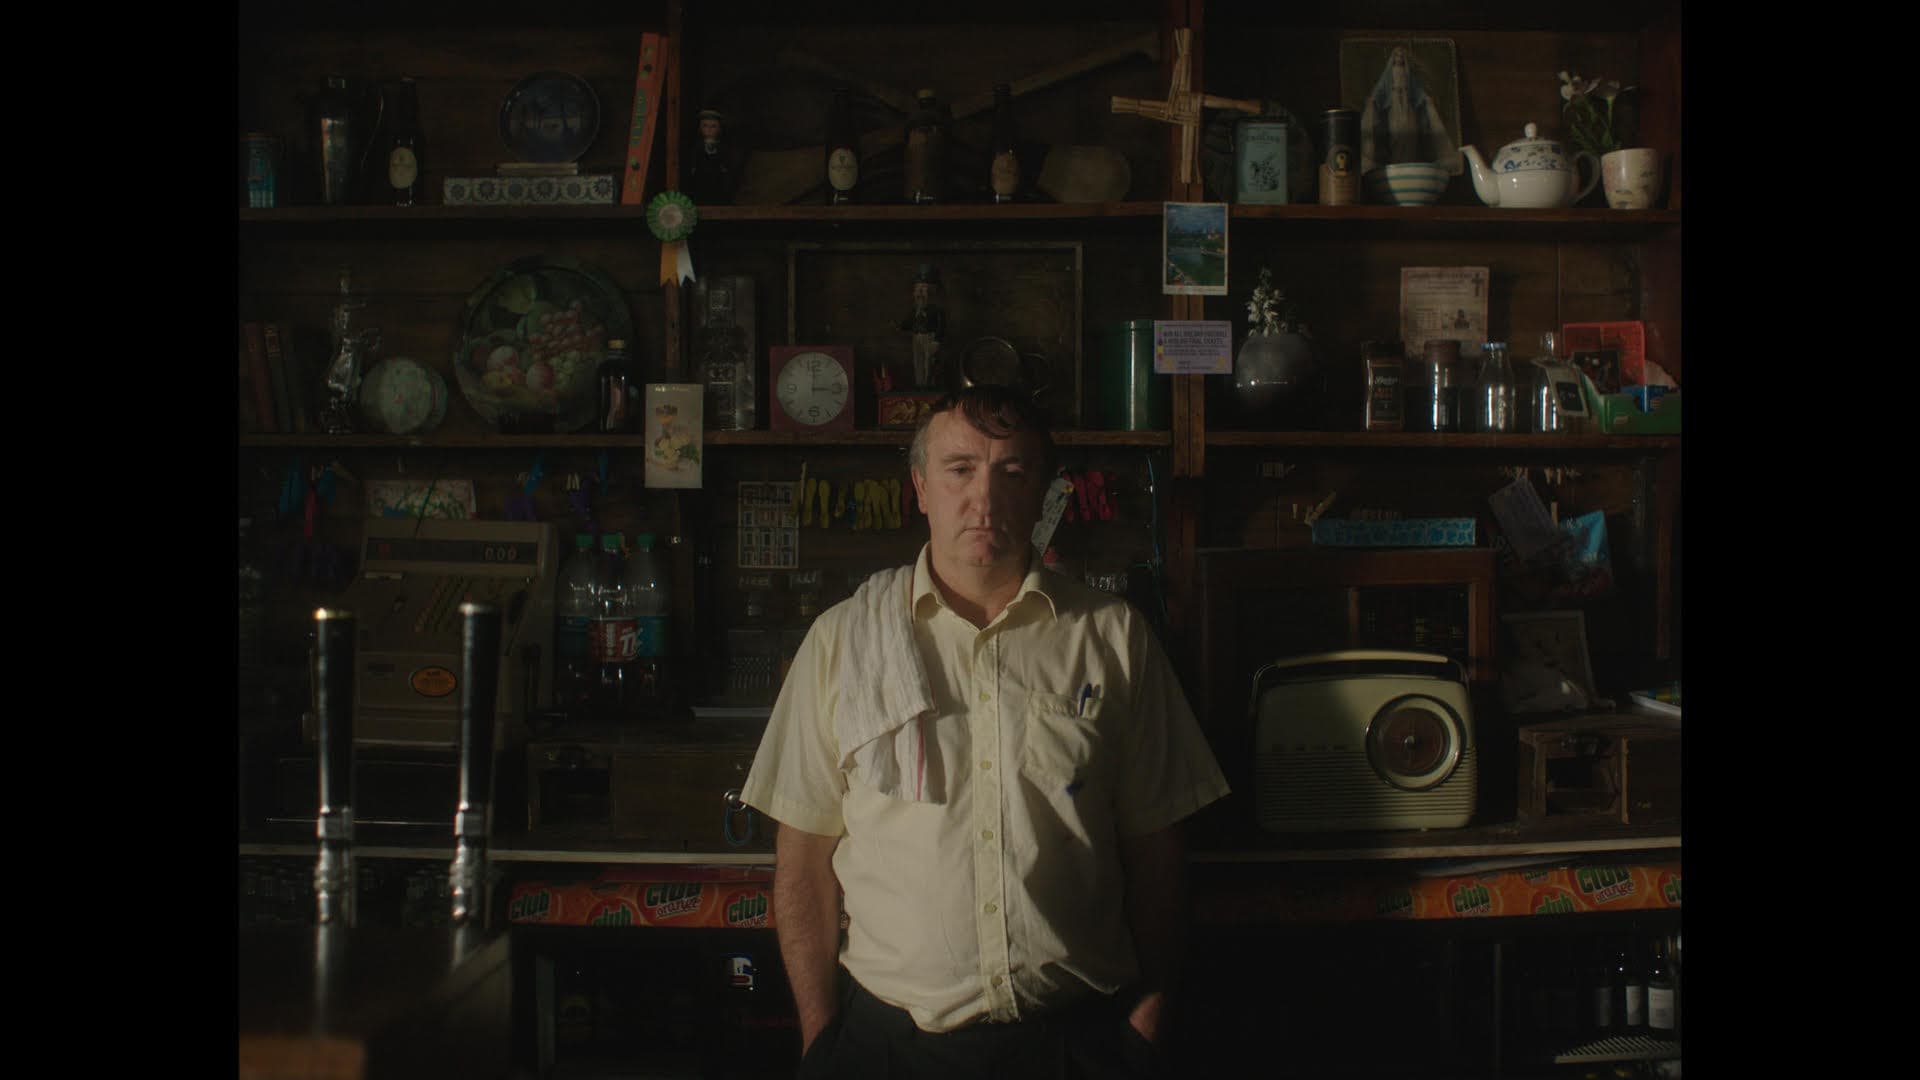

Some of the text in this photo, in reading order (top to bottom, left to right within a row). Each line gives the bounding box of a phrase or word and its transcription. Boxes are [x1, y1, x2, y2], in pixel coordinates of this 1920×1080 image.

[1575, 866, 1632, 894] club
[511, 891, 549, 919] club
[645, 883, 703, 908] club
[729, 892, 768, 923] club
[1453, 884, 1491, 912] club
